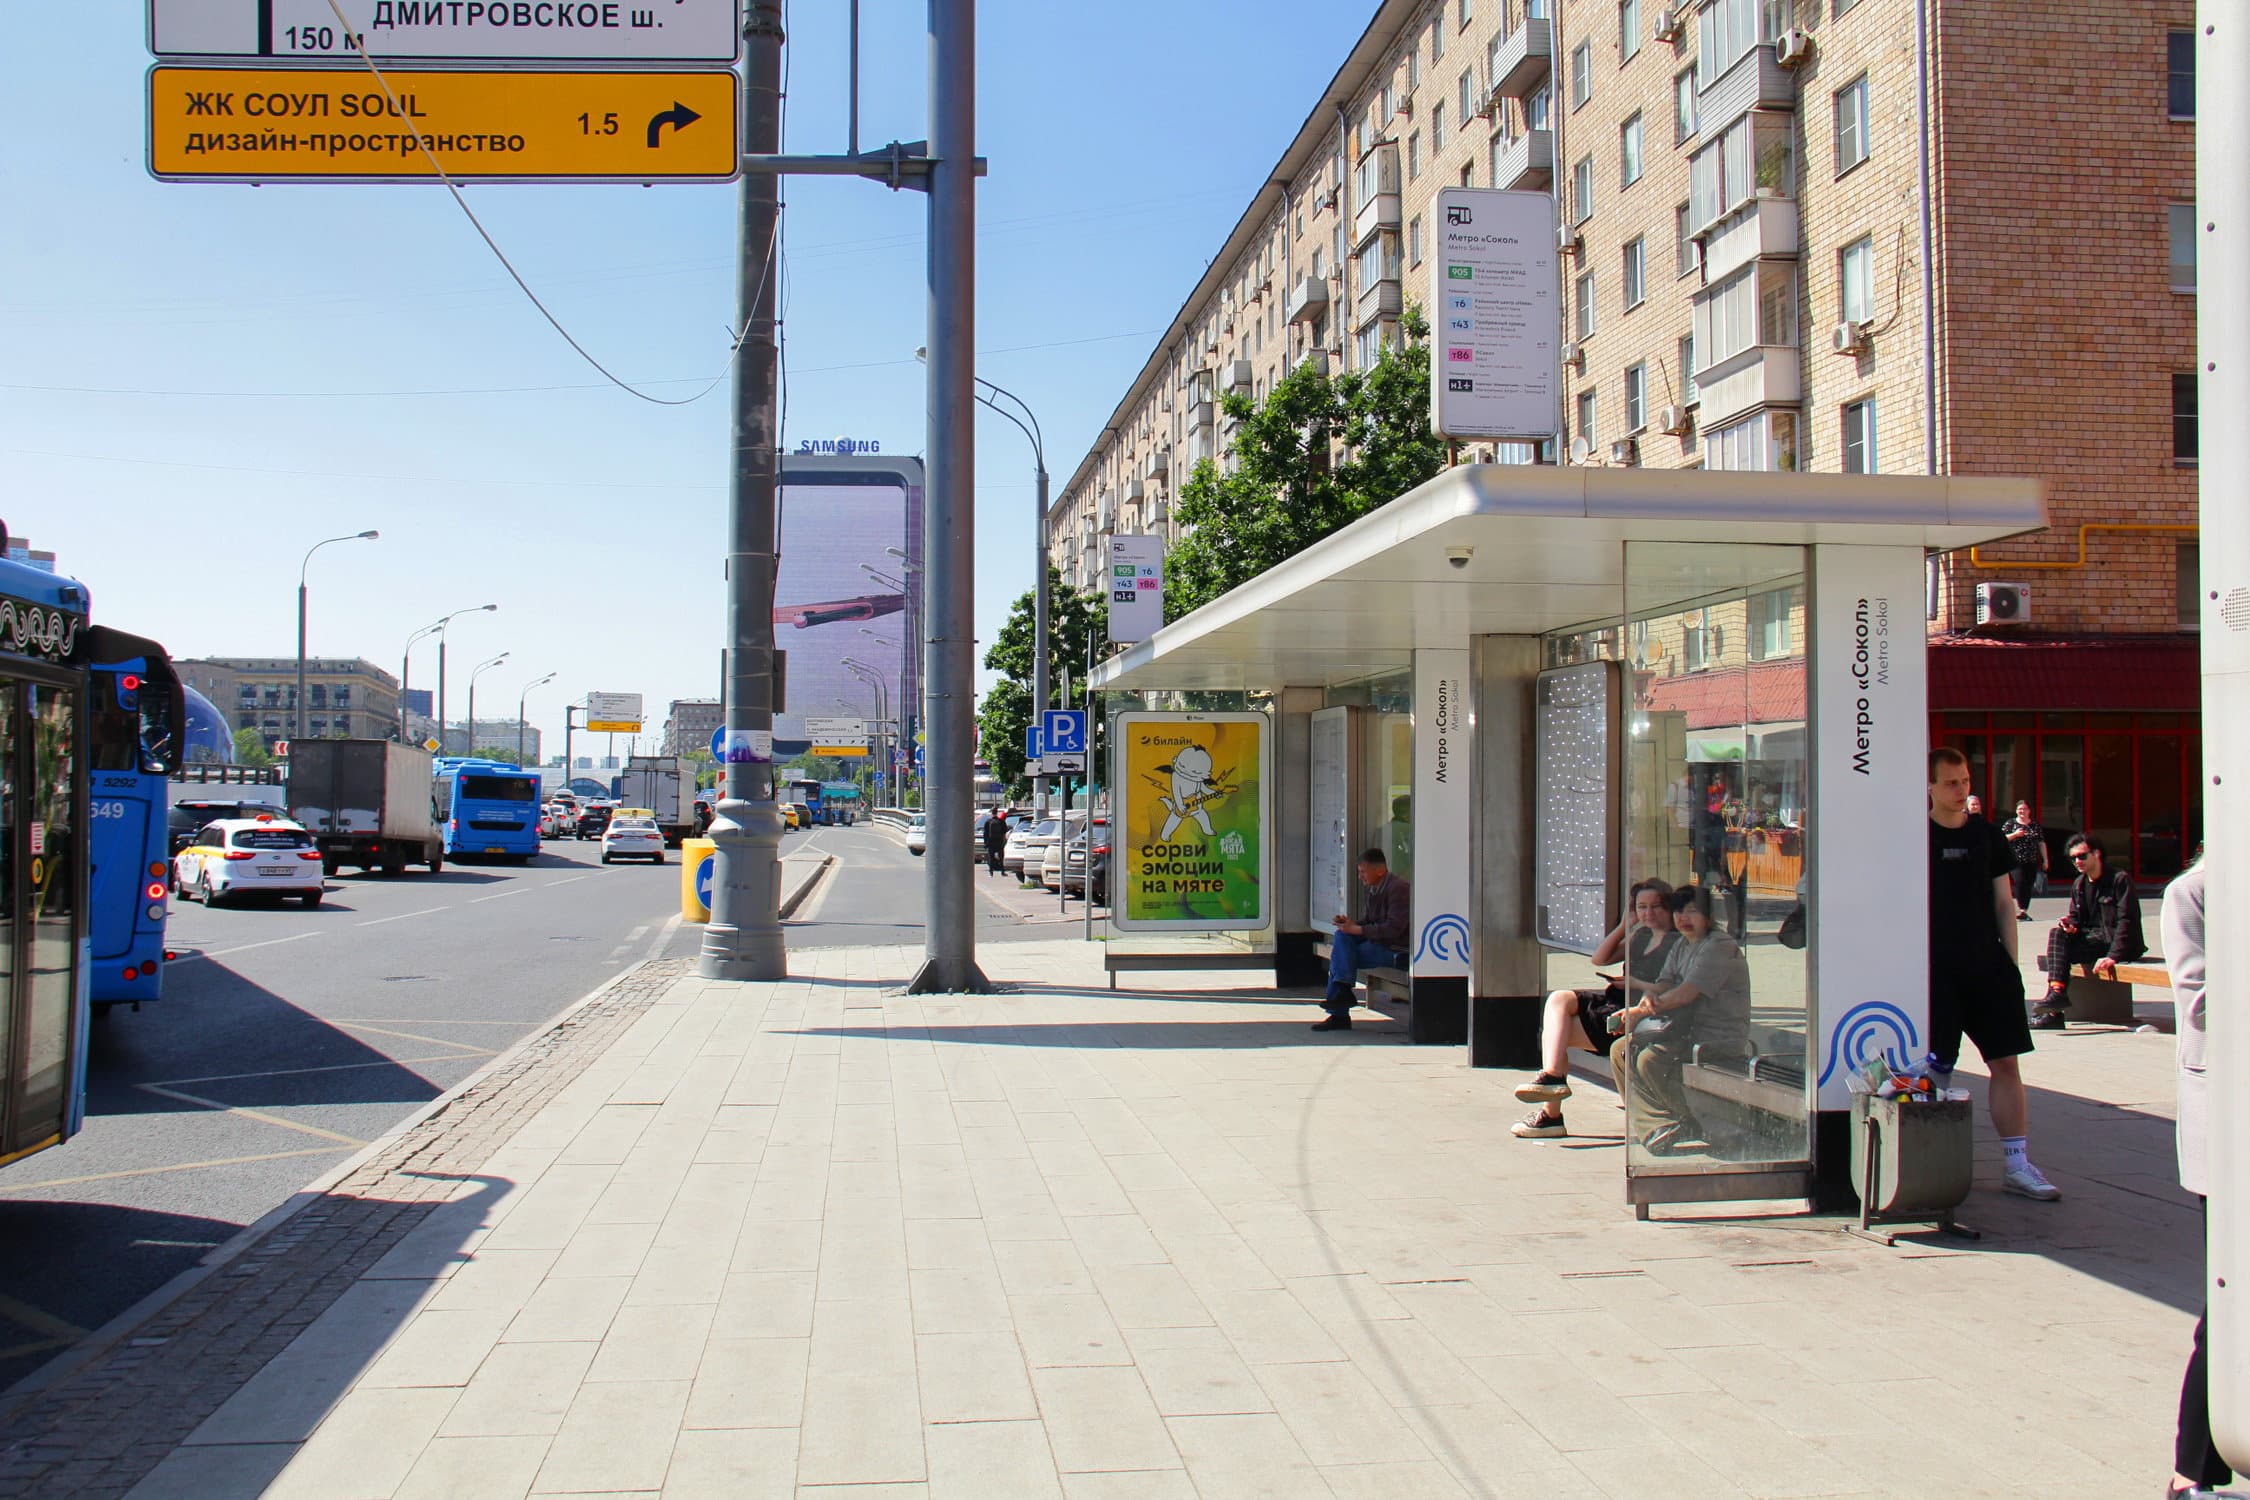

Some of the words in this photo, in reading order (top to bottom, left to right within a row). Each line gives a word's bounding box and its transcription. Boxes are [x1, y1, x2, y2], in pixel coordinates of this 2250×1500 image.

[373, 1, 619, 29] ДМИТРОВСКОЕ
[631, 9, 663, 28] ш.
[285, 26, 333, 49] 150
[344, 33, 363, 49] м
[185, 92, 234, 116] ЖК
[244, 93, 329, 117] СОУЛ
[340, 94, 427, 117] SOUL
[577, 112, 619, 136] 1.5
[185, 128, 525, 157] дизайн-пространство
[1448, 233, 1479, 244] Метро
[1452, 267, 1469, 277] 905
[1455, 299, 1466, 308] т6
[1452, 320, 1469, 329] т43
[1452, 350, 1470, 360] т86
[801, 439, 880, 453] SAMSUNG
[1117, 580, 1133, 588] т43
[1876, 597, 1889, 636] Sokol
[1851, 598, 1870, 690] «Сокол»
[1877, 640, 1889, 686] Metro
[1450, 679, 1459, 704] Sokol
[1435, 679, 1447, 735] «Сокол»
[1451, 706, 1460, 732] Metro
[1153, 735, 1193, 746] билайн
[1853, 698, 1873, 775] Метро
[1436, 738, 1449, 783] Метро
[104, 777, 138, 788] 5292
[1142, 844, 1206, 862] сорви
[1142, 861, 1224, 879] эмоции
[1142, 880, 1167, 893] на
[1173, 879, 1225, 893] мяте
